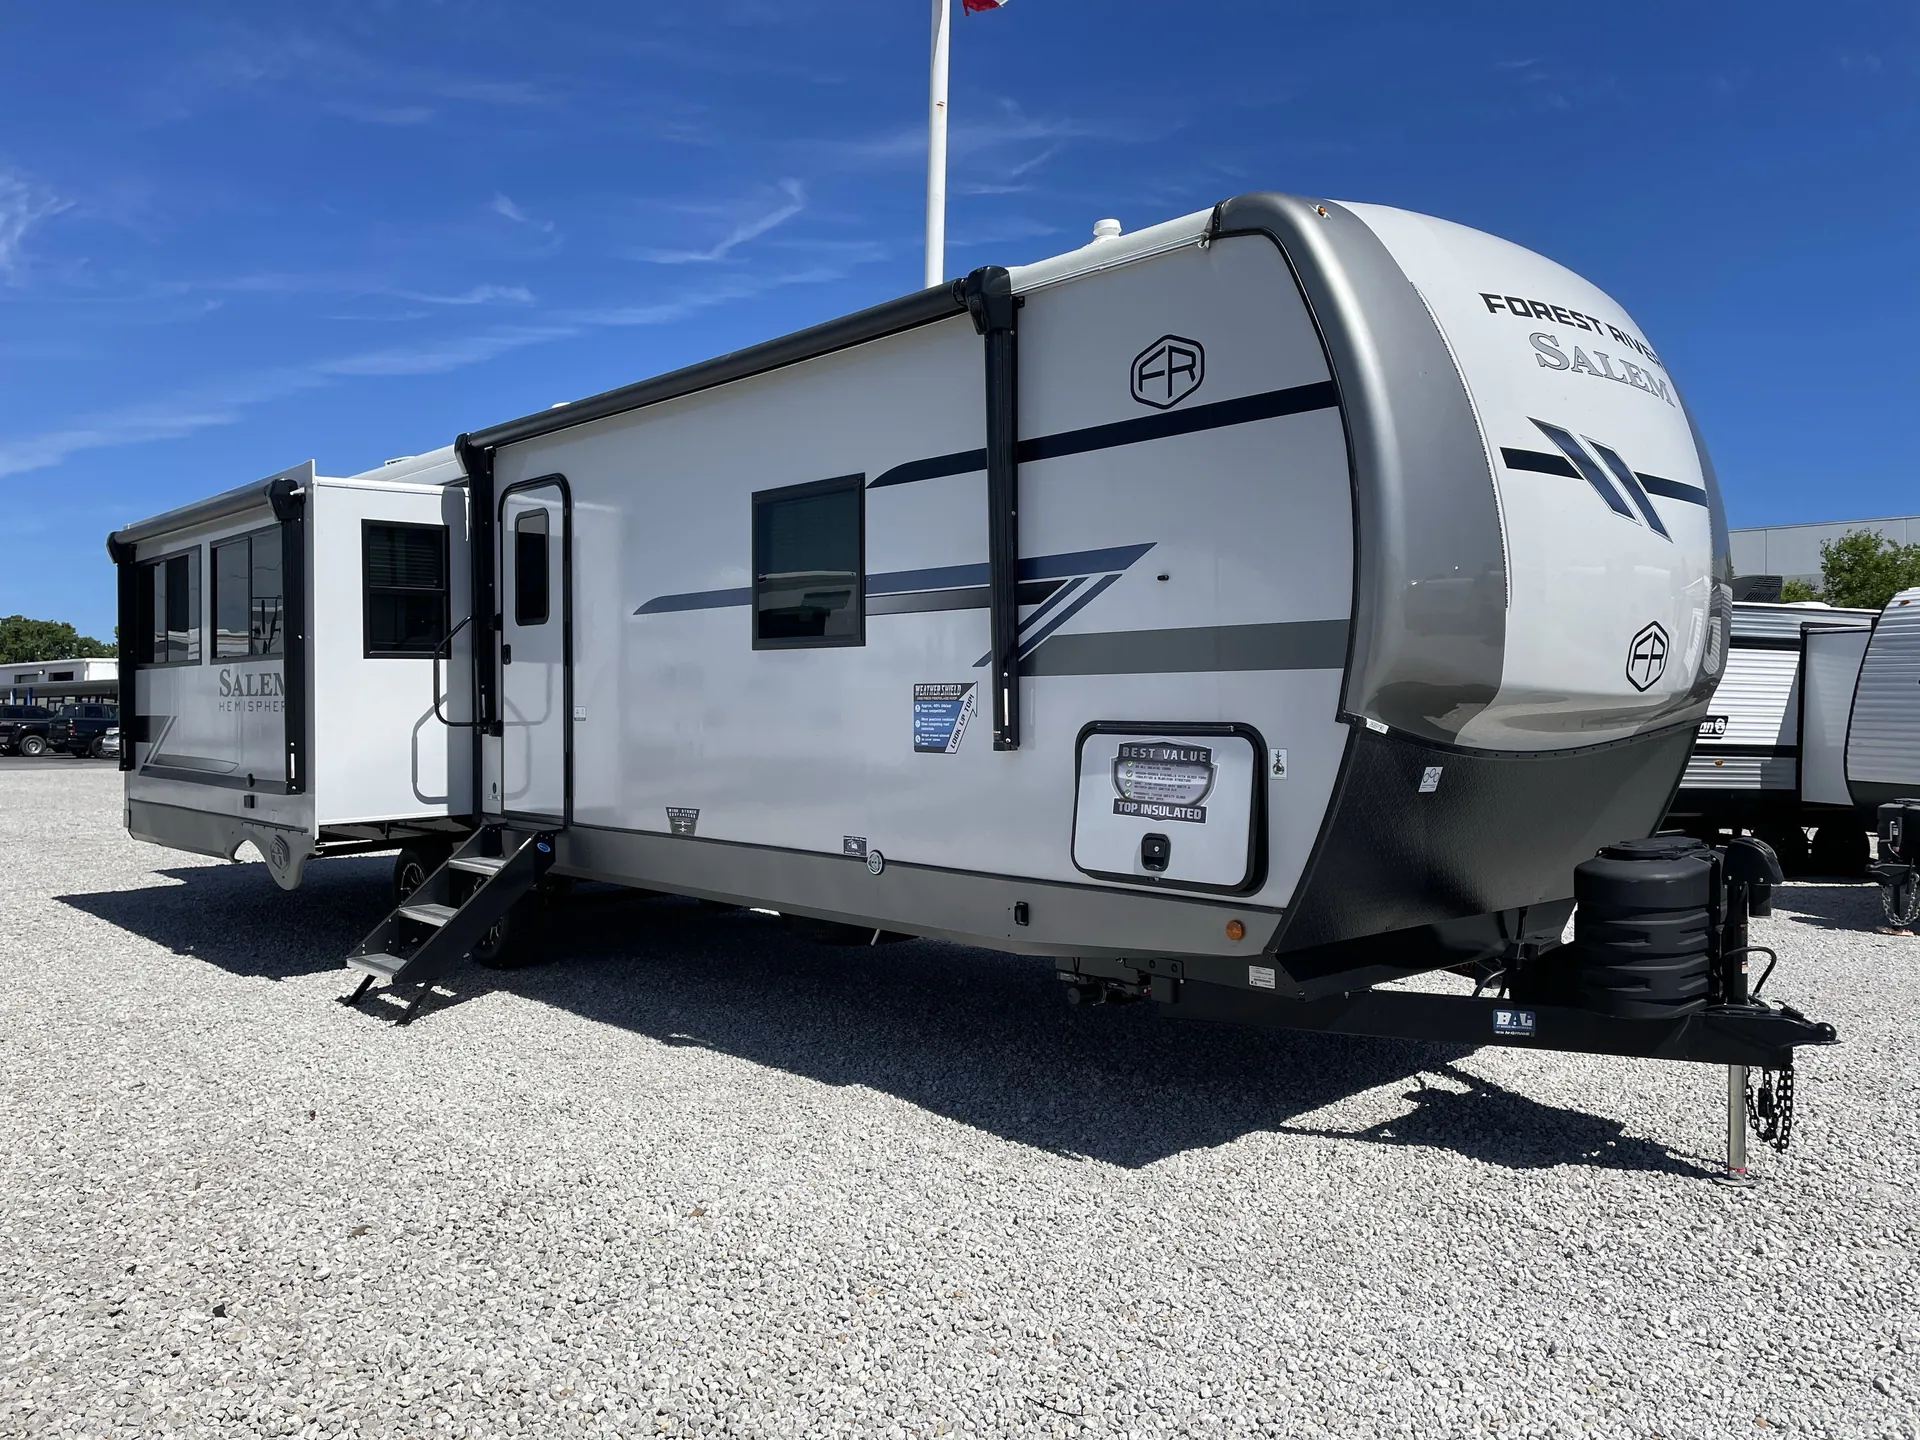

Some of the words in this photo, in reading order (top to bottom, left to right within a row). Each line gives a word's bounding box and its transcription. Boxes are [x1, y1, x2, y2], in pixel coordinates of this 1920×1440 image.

[1478, 292, 1604, 336] FOREST
[1529, 331, 1676, 408] SALEM
[950, 728, 962, 749] LOOK
[959, 714, 966, 726] UP
[1122, 746, 1156, 758] BEST
[1162, 749, 1207, 762] VALUE
[1117, 801, 1138, 813] TOP
[1140, 803, 1202, 820] INSULATED
